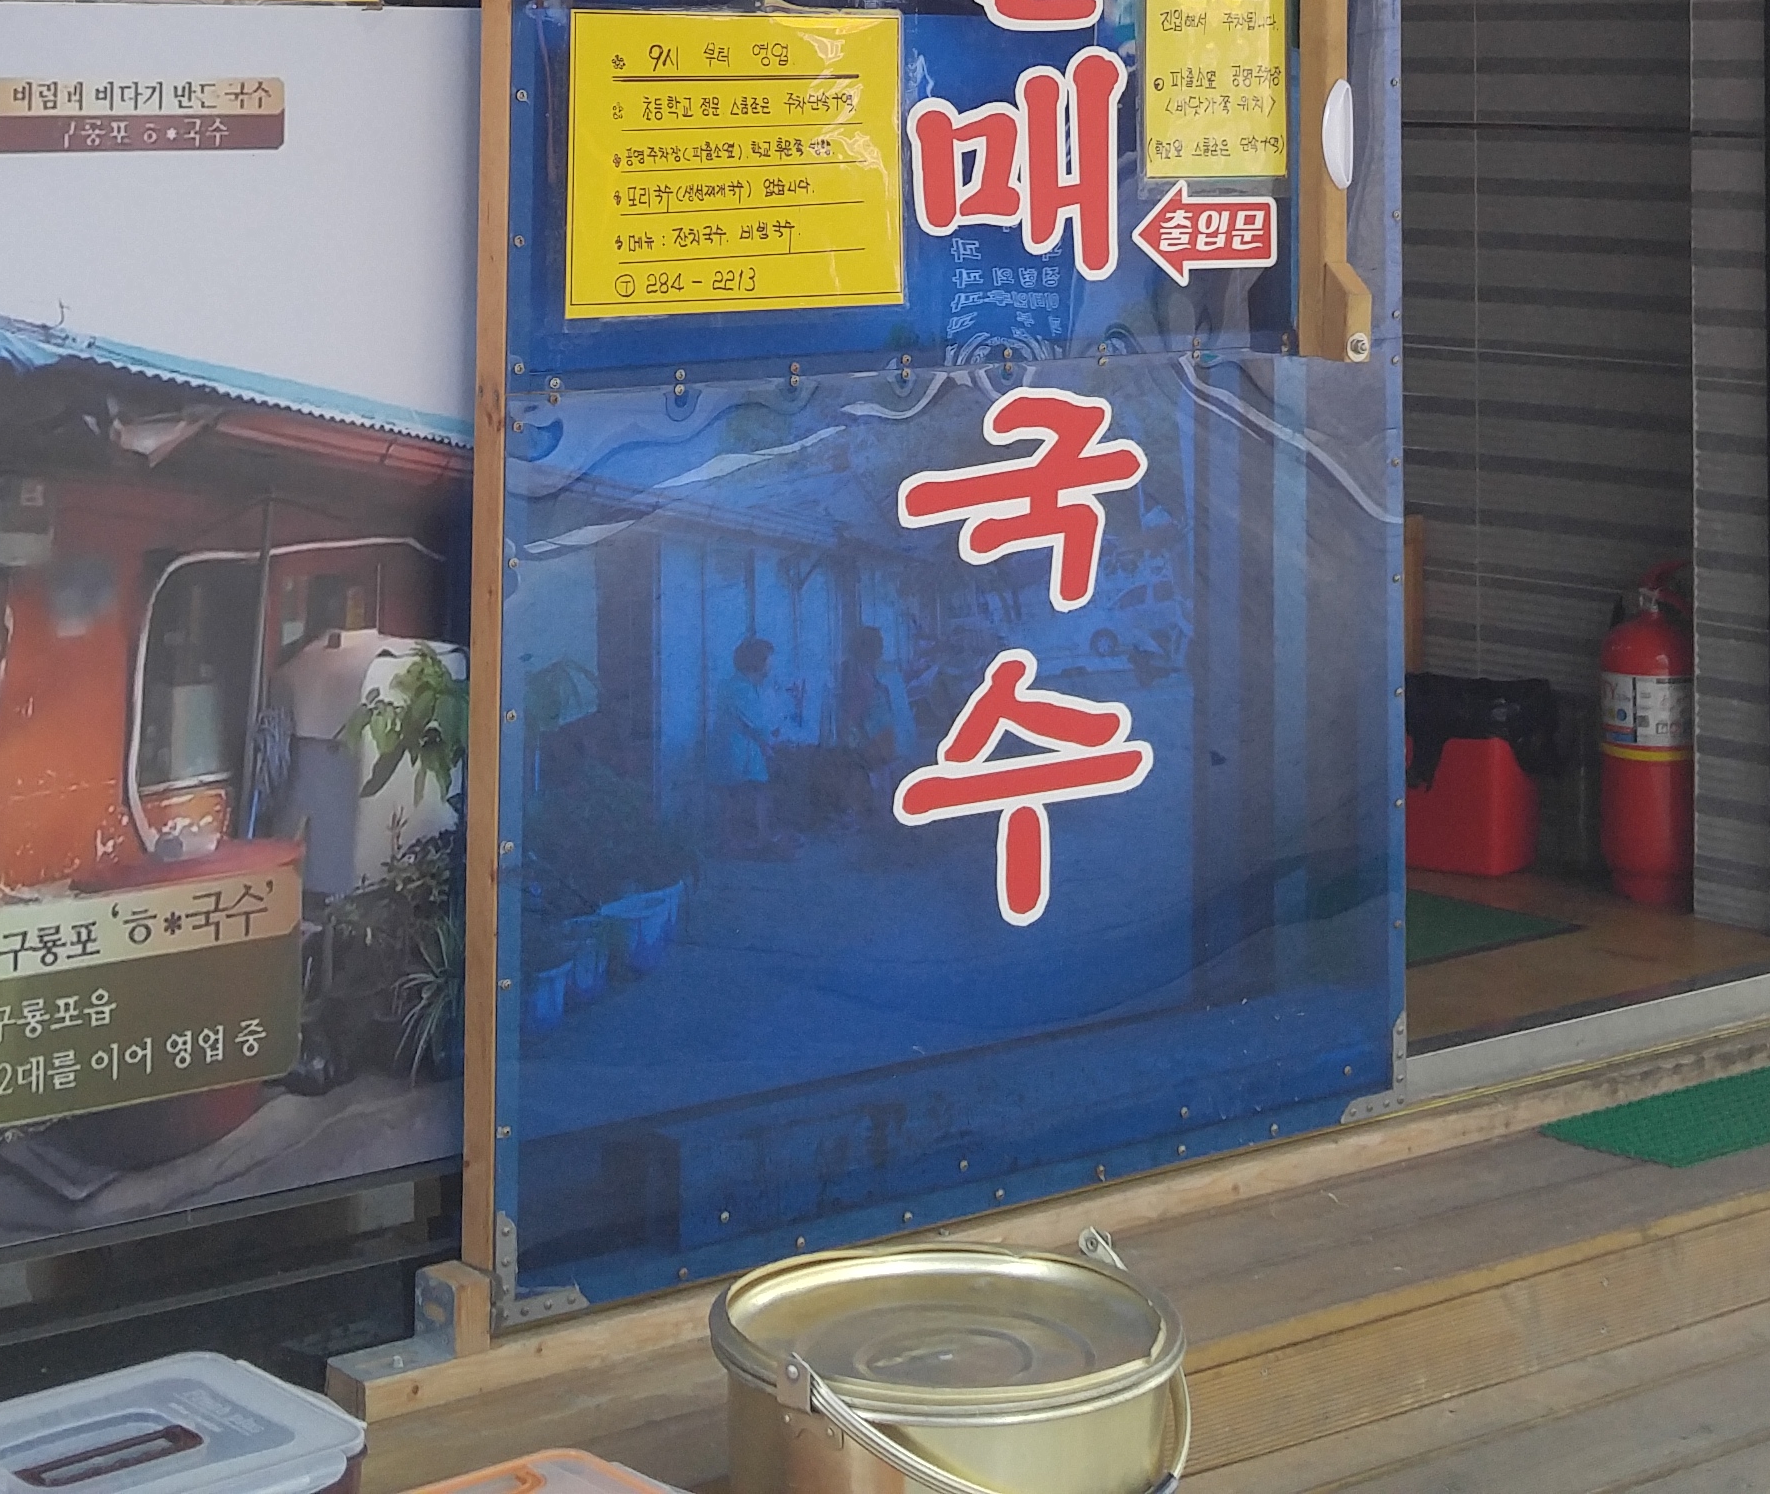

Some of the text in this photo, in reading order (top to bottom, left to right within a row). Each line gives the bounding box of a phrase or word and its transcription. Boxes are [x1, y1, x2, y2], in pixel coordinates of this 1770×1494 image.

[648, 44, 679, 71] 9시
[704, 42, 730, 67] 부터
[642, 96, 694, 121] 초등학교
[1159, 209, 1266, 251] 출입문
[90, 1035, 154, 1079] 이어
[165, 1024, 226, 1067] 영업
[235, 1018, 268, 1057] 중
